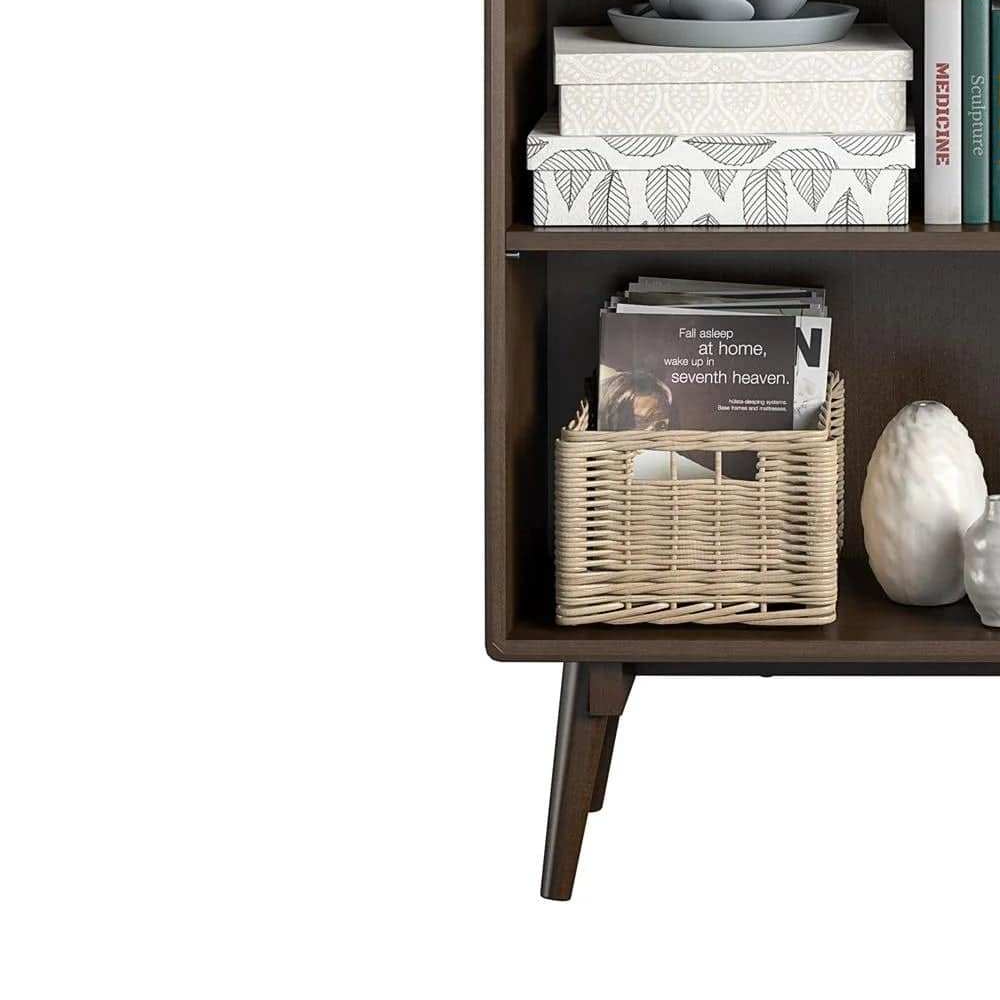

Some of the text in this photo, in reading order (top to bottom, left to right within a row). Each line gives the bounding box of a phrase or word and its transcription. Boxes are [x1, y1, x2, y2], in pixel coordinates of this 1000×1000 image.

[935, 63, 951, 166] MEDICINE
[968, 74, 985, 157] Sculpture
[679, 328, 734, 341] Fall asleep
[698, 341, 768, 358] at home,
[663, 356, 715, 368] wake up in
[671, 371, 791, 385] seventh heaven.
